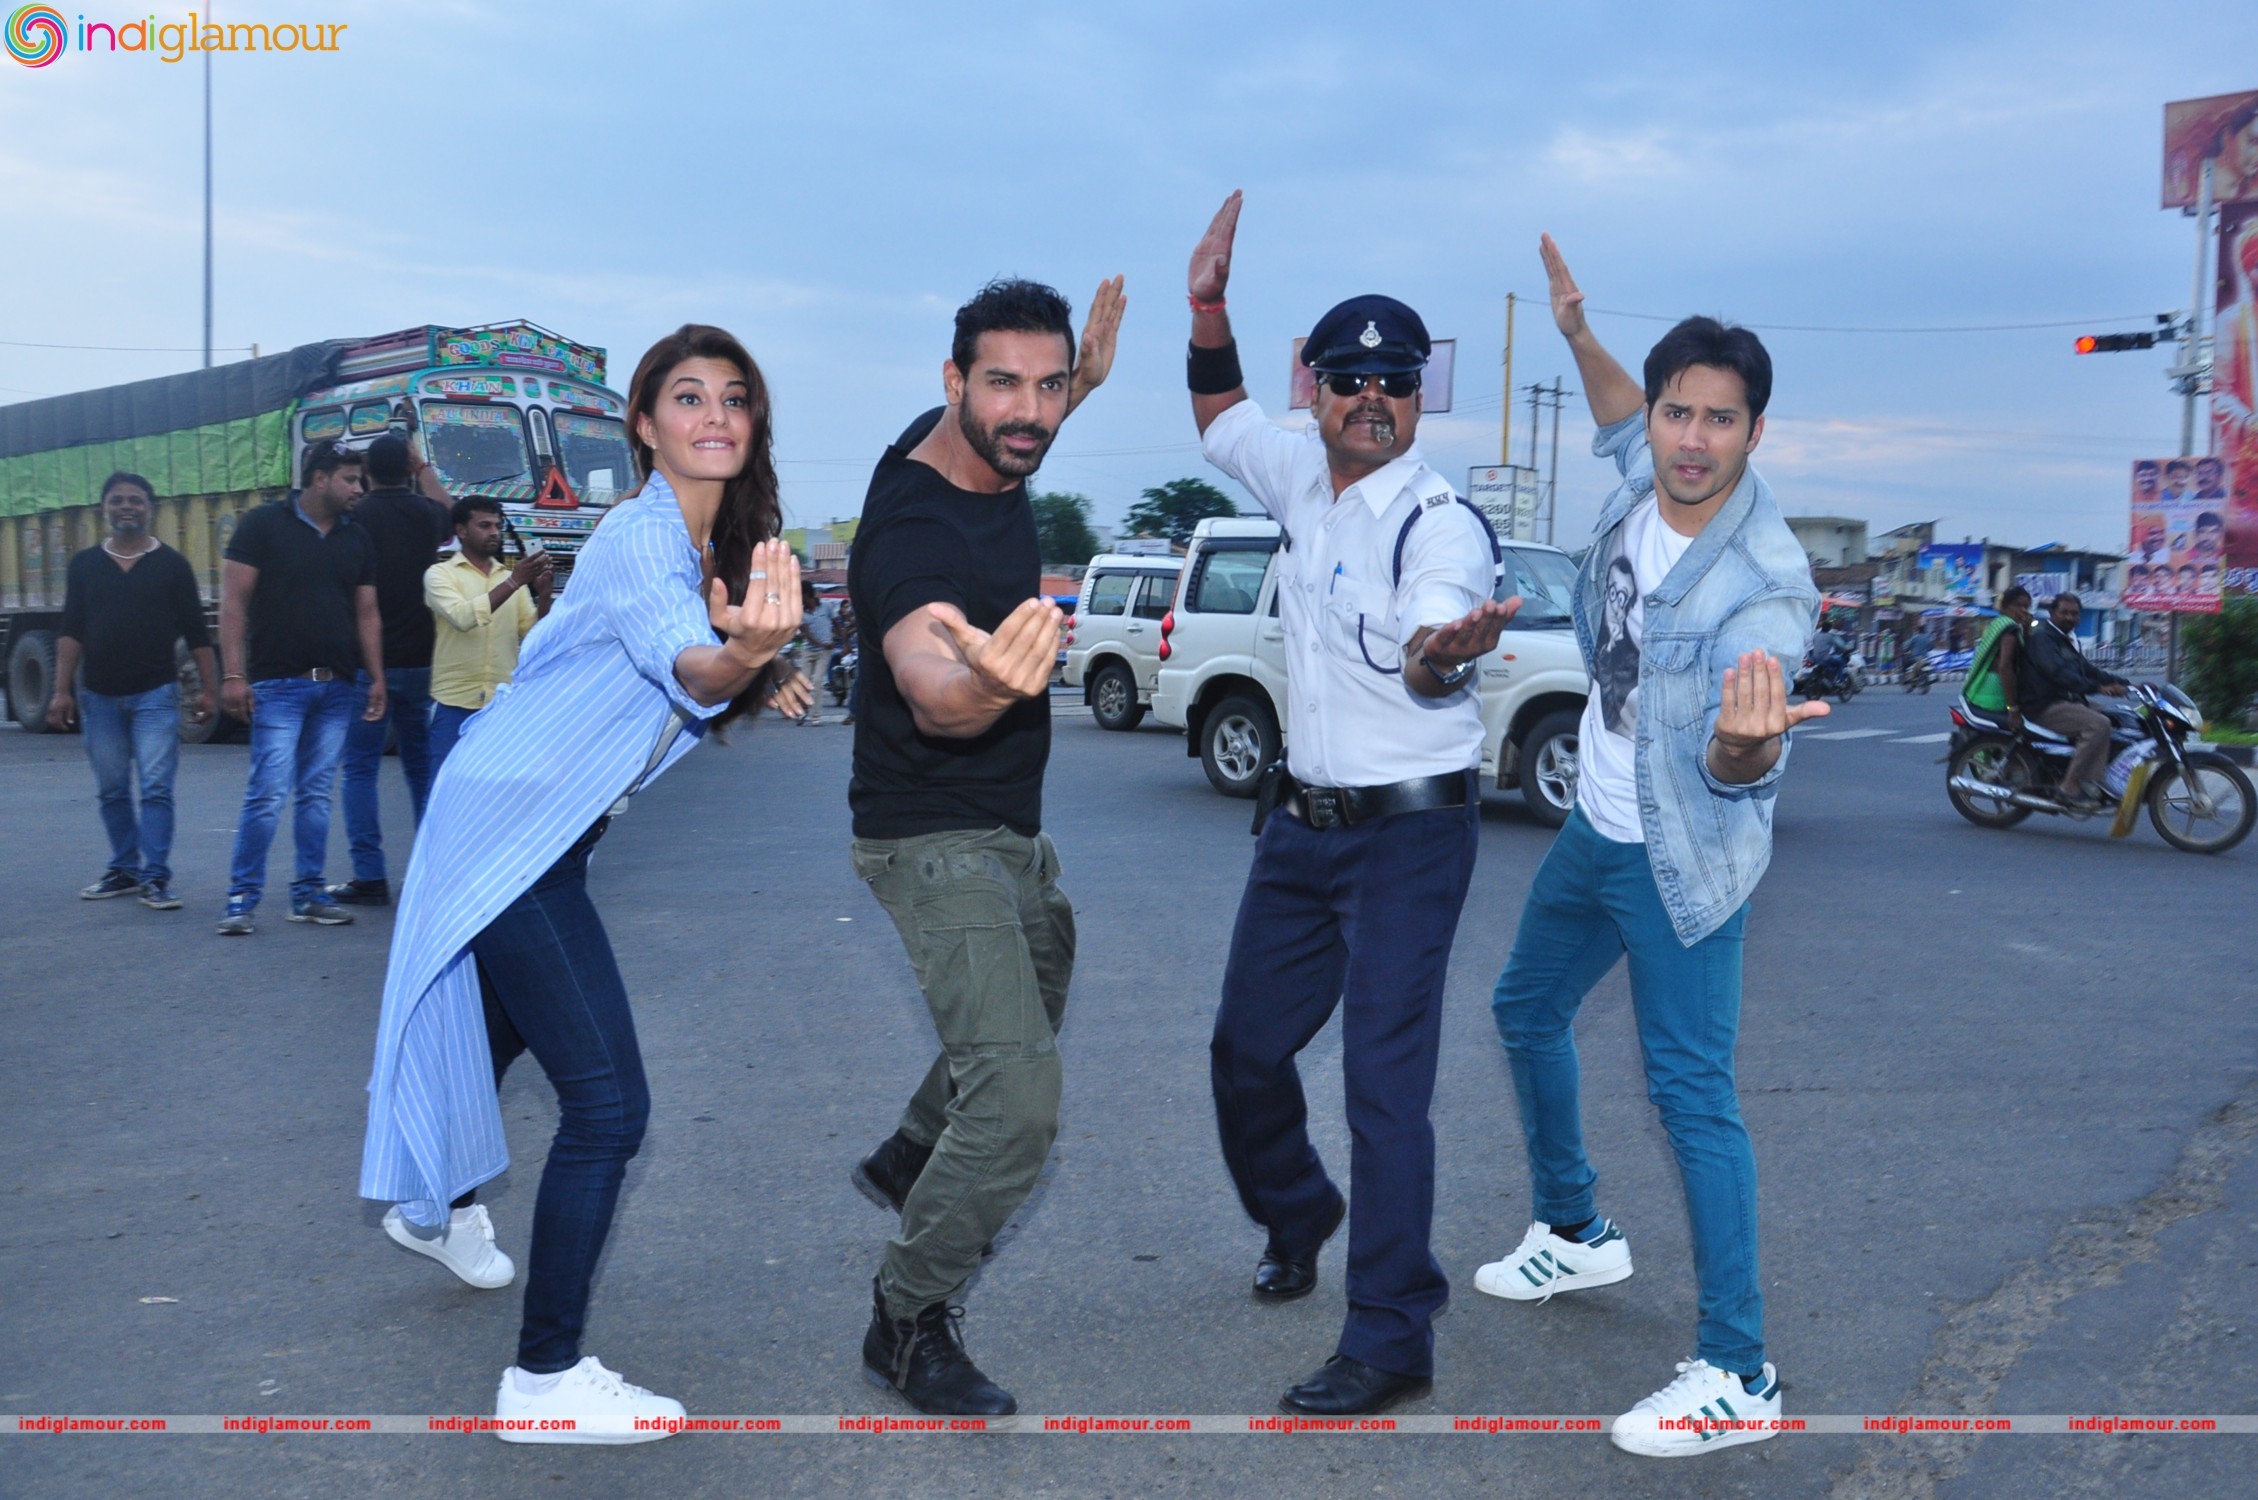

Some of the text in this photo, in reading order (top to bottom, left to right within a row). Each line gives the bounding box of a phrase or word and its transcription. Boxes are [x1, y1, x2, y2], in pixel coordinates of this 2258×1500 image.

[448, 339, 501, 356] GOODS
[547, 345, 596, 375] CARRIER
[442, 381, 503, 393] KHAN
[465, 409, 504, 421] INDIA
